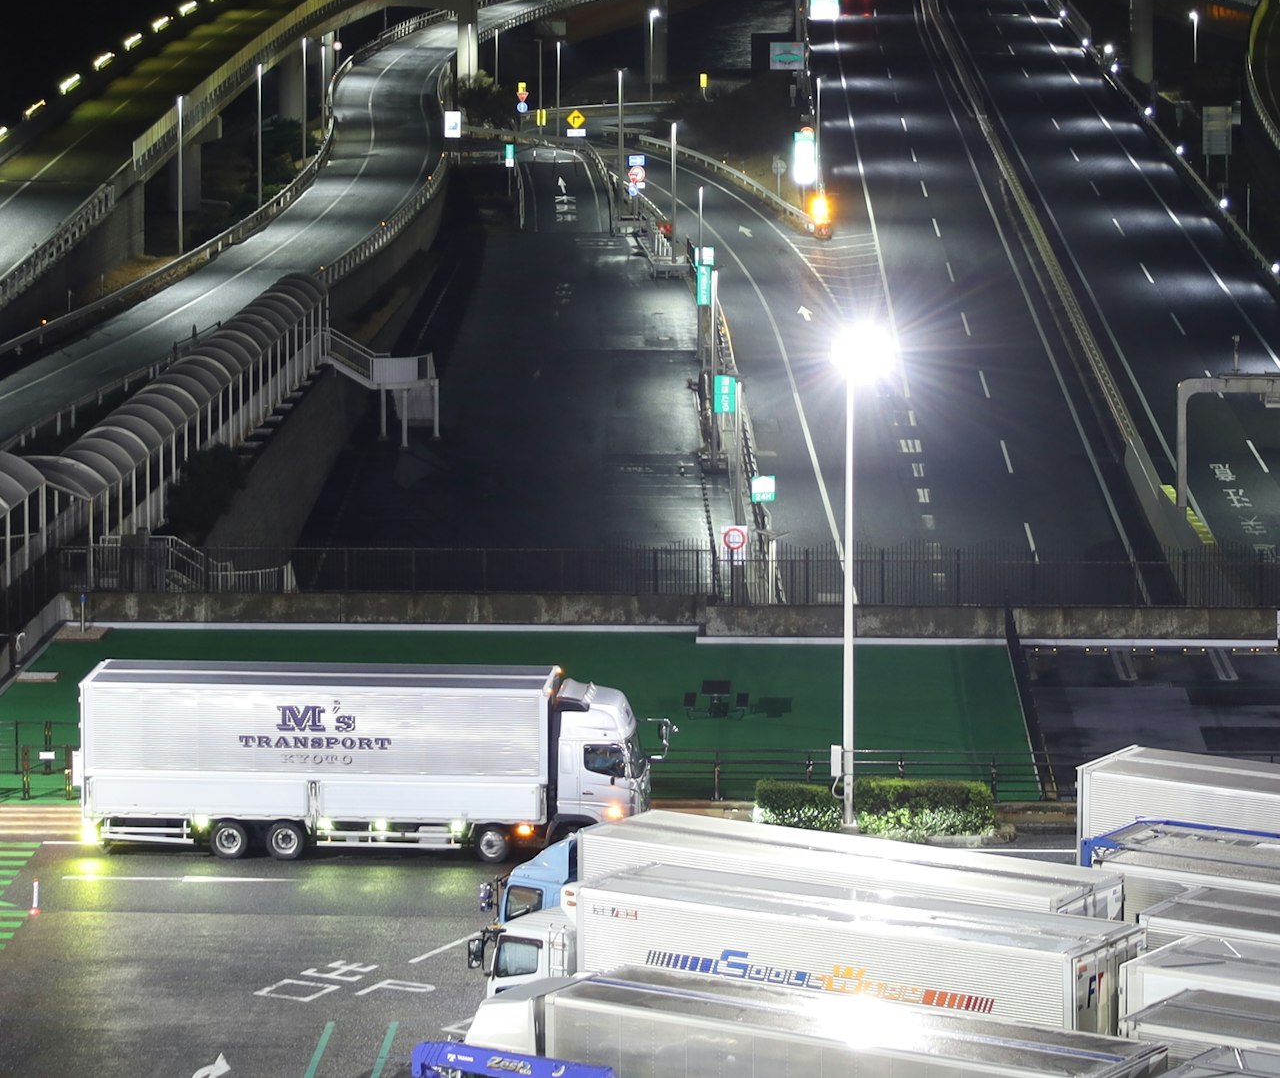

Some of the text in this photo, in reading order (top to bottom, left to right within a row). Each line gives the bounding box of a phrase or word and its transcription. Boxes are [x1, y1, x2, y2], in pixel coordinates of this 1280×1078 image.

[755, 493, 772, 501] 24H
[277, 700, 356, 732] M's
[239, 735, 392, 750] TRANSPORT
[281, 754, 353, 765] KYOTO
